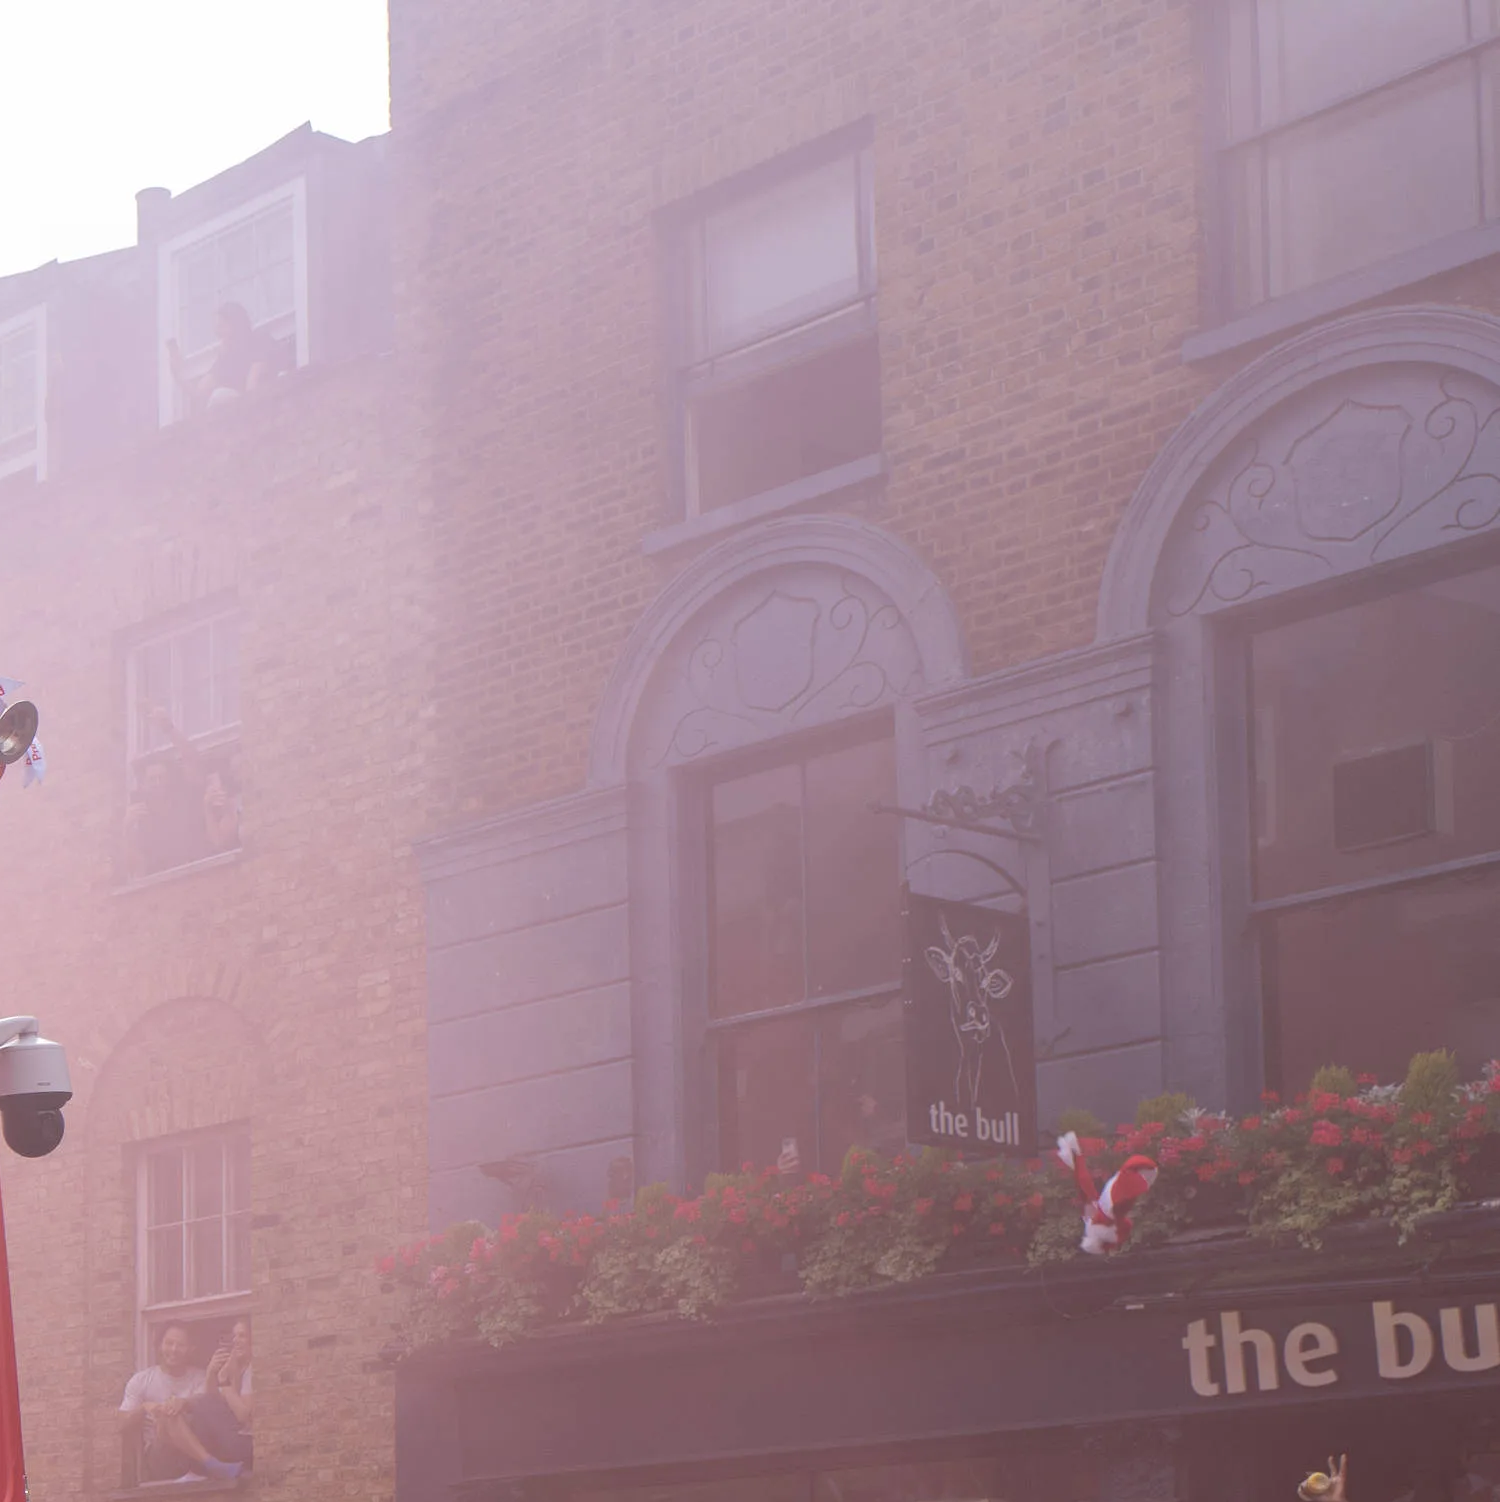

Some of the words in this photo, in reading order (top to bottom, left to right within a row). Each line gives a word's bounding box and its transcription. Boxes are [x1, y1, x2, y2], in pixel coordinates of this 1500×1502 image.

[928, 1102, 968, 1140] the
[975, 1107, 1021, 1147] bull
[1182, 1309, 1338, 1399] the
